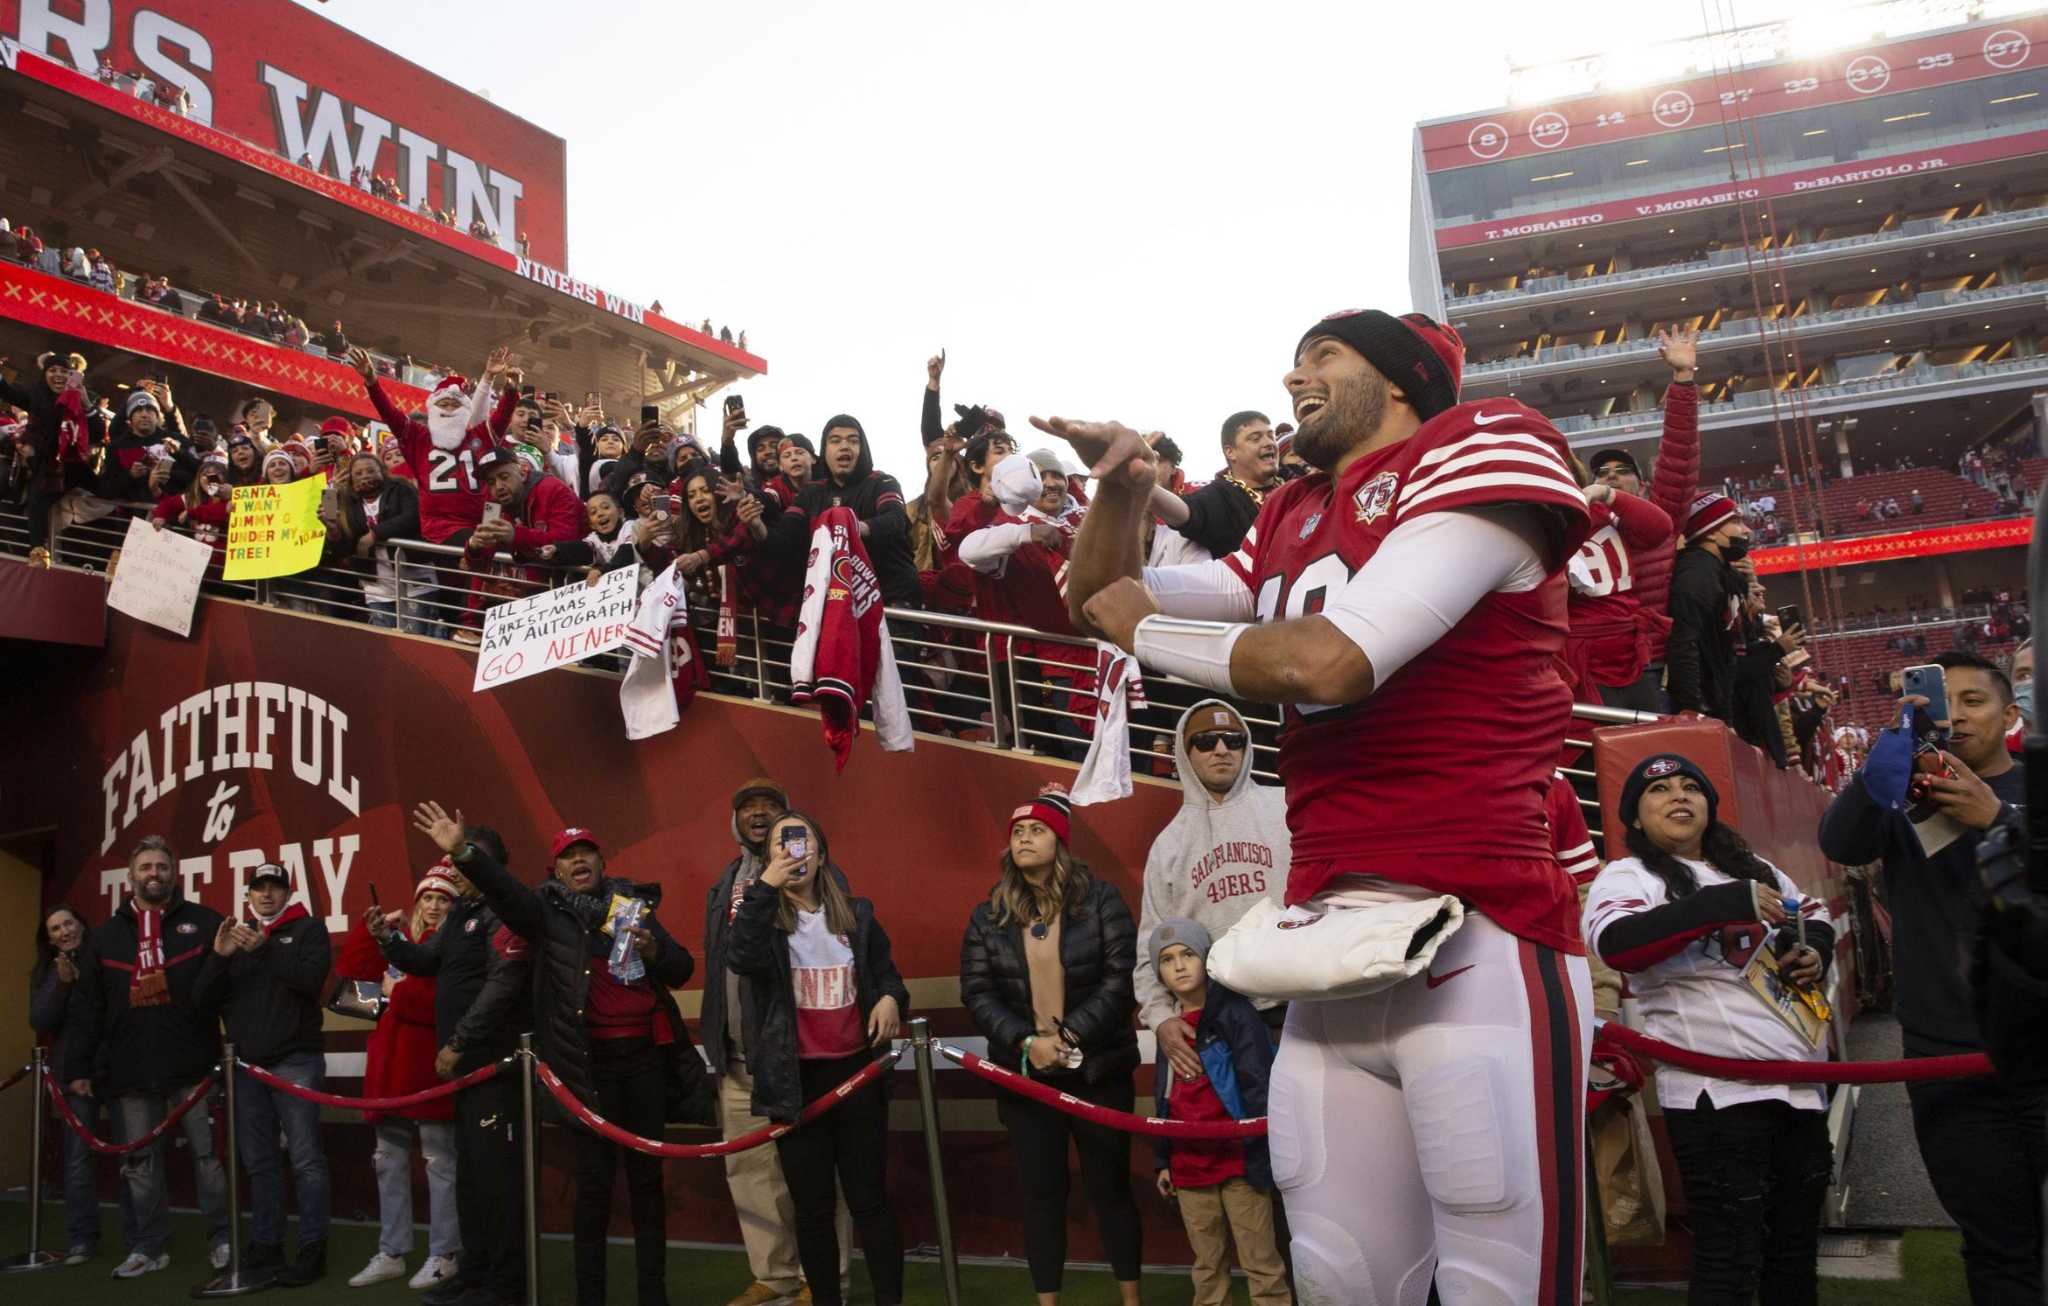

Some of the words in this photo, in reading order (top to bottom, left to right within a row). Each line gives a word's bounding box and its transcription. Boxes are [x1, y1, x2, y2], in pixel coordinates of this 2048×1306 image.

[1988, 39, 2023, 56] 37
[1917, 53, 1954, 70] 35
[1849, 67, 1889, 83] 34
[1784, 78, 1819, 95] 33
[1720, 88, 1753, 105] 27
[1597, 111, 1627, 127] 14
[1535, 122, 1564, 138] 12
[1480, 133, 1498, 147] 8
[264, 64, 523, 257] WIN
[1917, 158, 1949, 171] JR.
[1636, 205, 1653, 216] V.
[1655, 189, 1759, 213] MORABITO
[1485, 229, 1500, 240] T.
[1503, 213, 1604, 237] MORABITO
[515, 257, 598, 307] NINERS
[604, 290, 645, 325] WIN
[429, 449, 478, 490] 21
[233, 486, 281, 500] SANTA,
[244, 500, 281, 512] WANT
[231, 514, 275, 528] JIMMY
[230, 530, 275, 543] UNDER
[281, 528, 298, 540] MY
[487, 604, 516, 621] ALL
[521, 596, 540, 611] I
[607, 570, 635, 585] FOR
[485, 597, 586, 640] CHRISTMAS
[598, 584, 625, 603] IS
[484, 634, 512, 652] AN
[523, 600, 633, 641] AUTOGRAPH
[482, 652, 524, 682] GO
[100, 681, 360, 857] FAITHFUL
[203, 780, 240, 843] to
[1207, 870, 1266, 904] 49ERS
